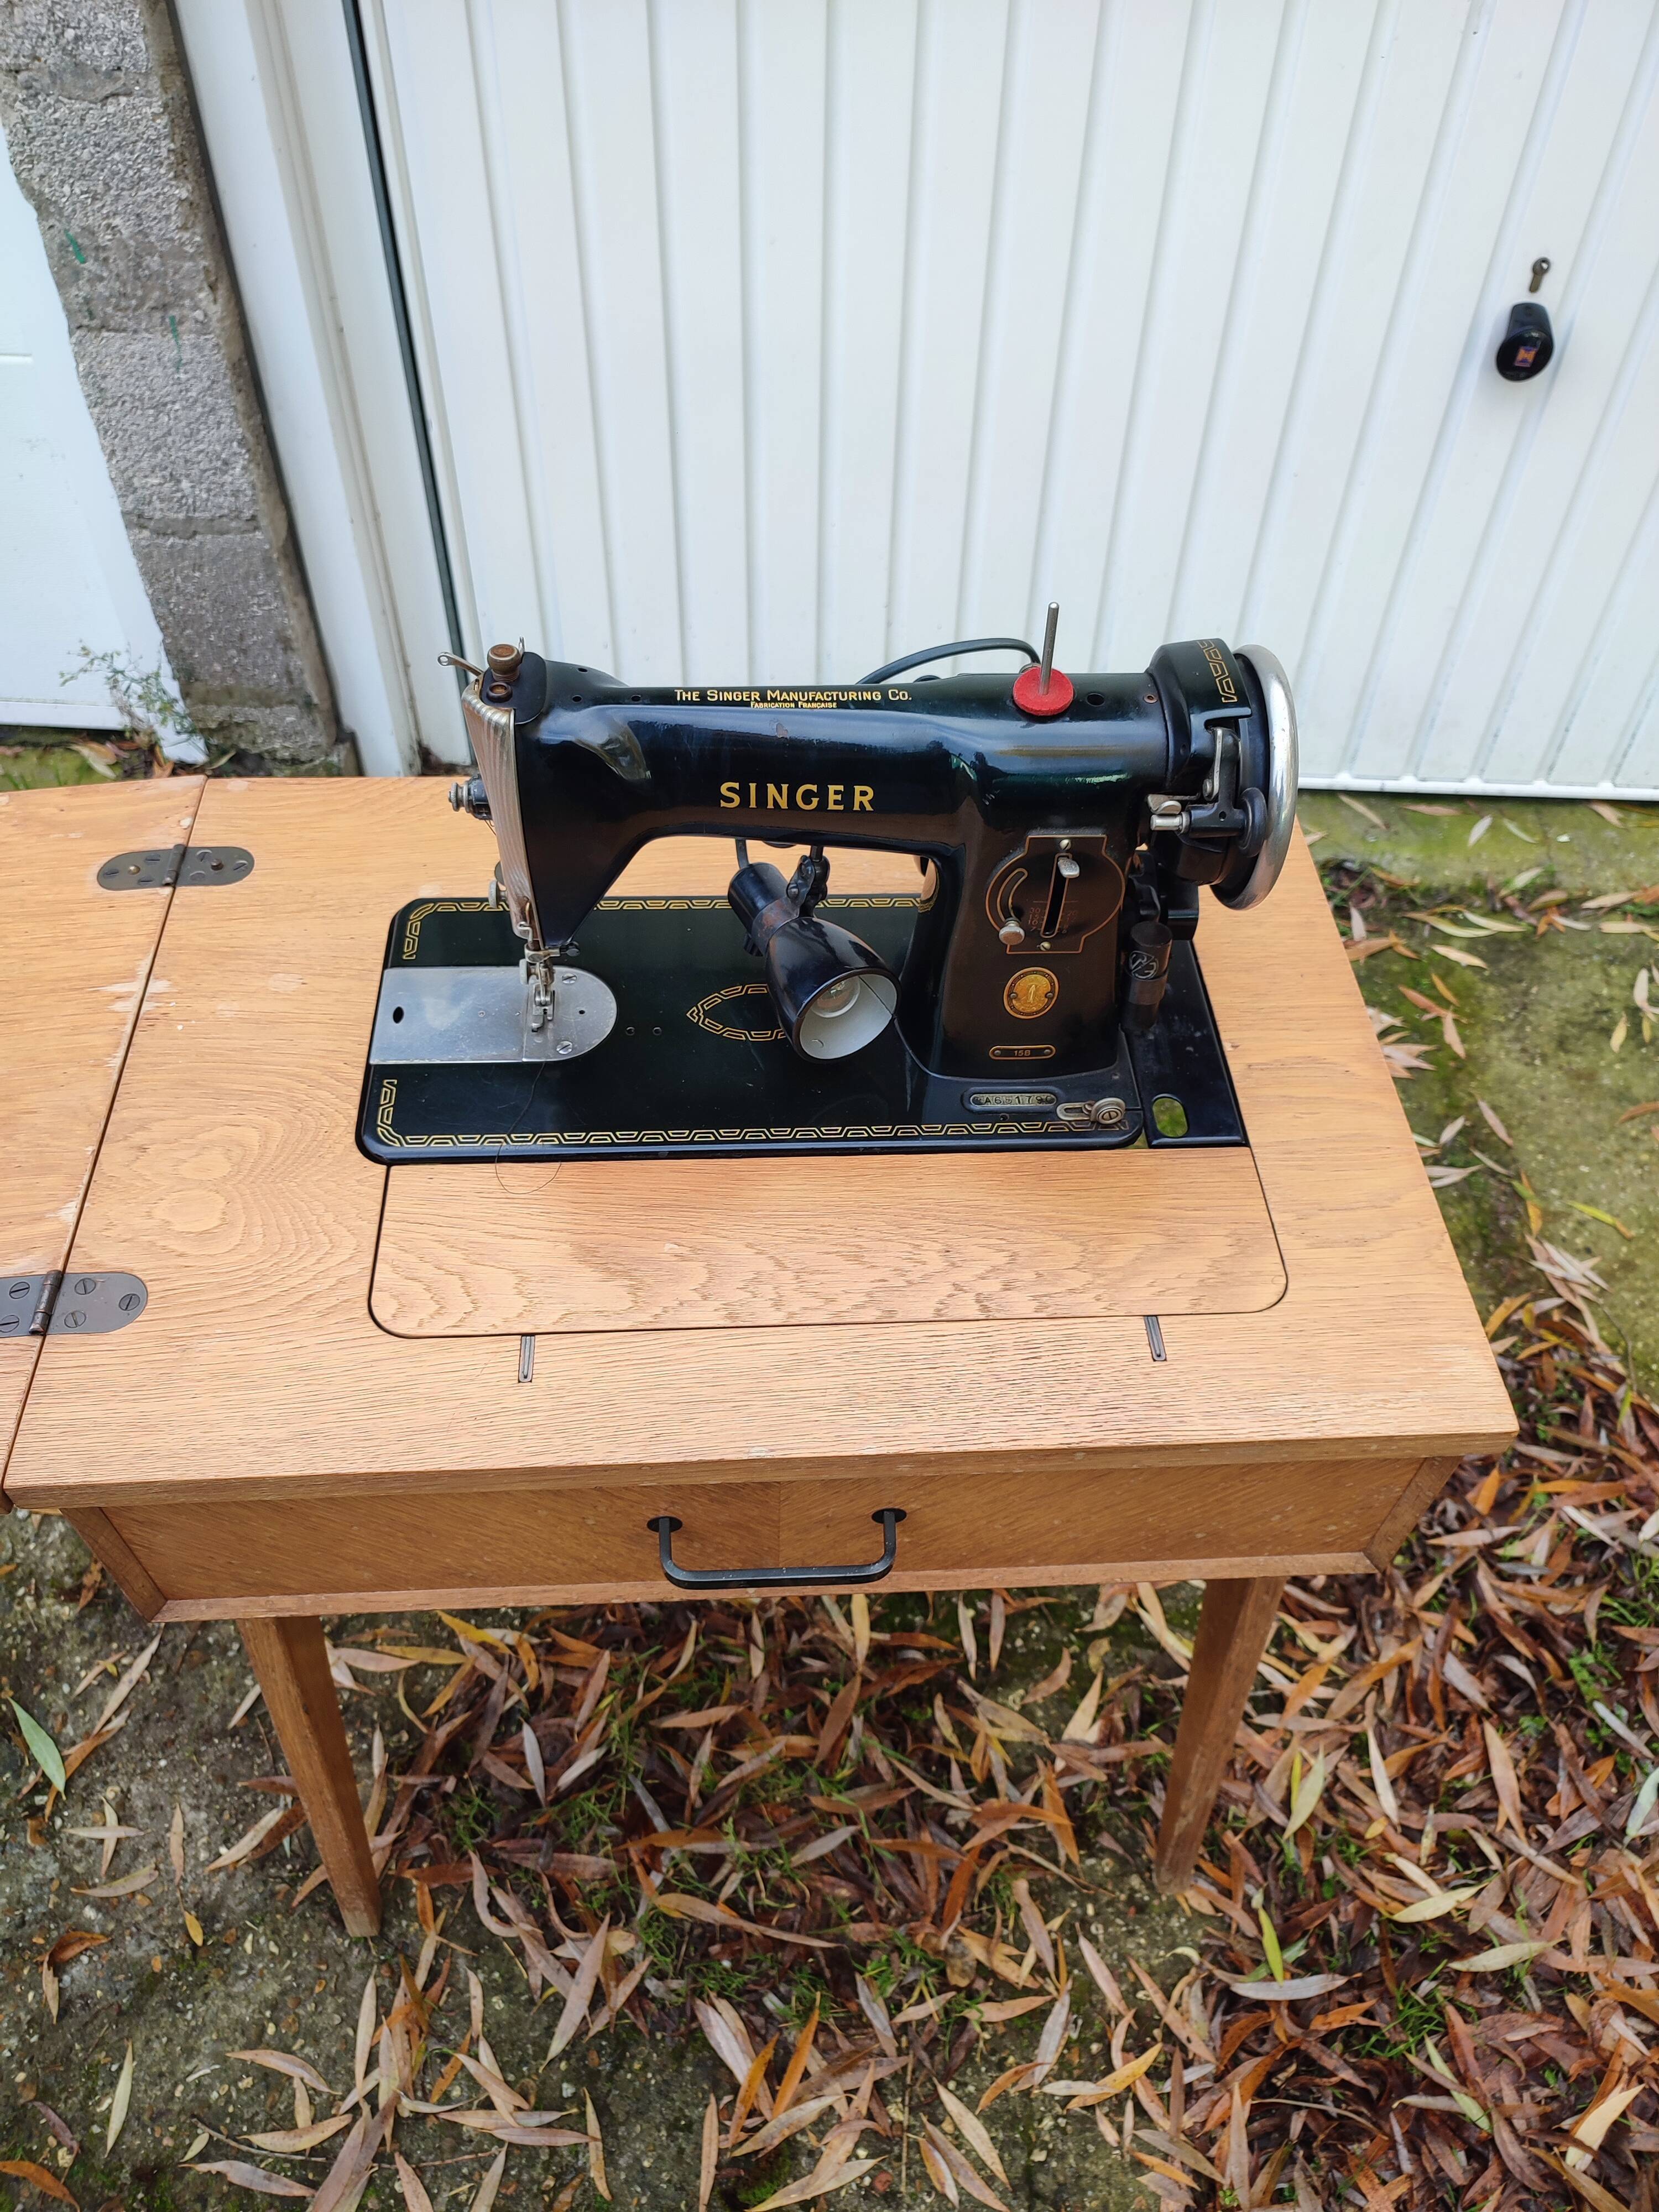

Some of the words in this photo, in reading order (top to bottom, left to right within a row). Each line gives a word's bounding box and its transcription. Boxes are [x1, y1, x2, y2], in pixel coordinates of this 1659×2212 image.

[674, 690, 701, 701] THE
[707, 690, 760, 701] SINGER
[767, 690, 881, 701] MANUFACTURING
[720, 782, 874, 811] SINGER
